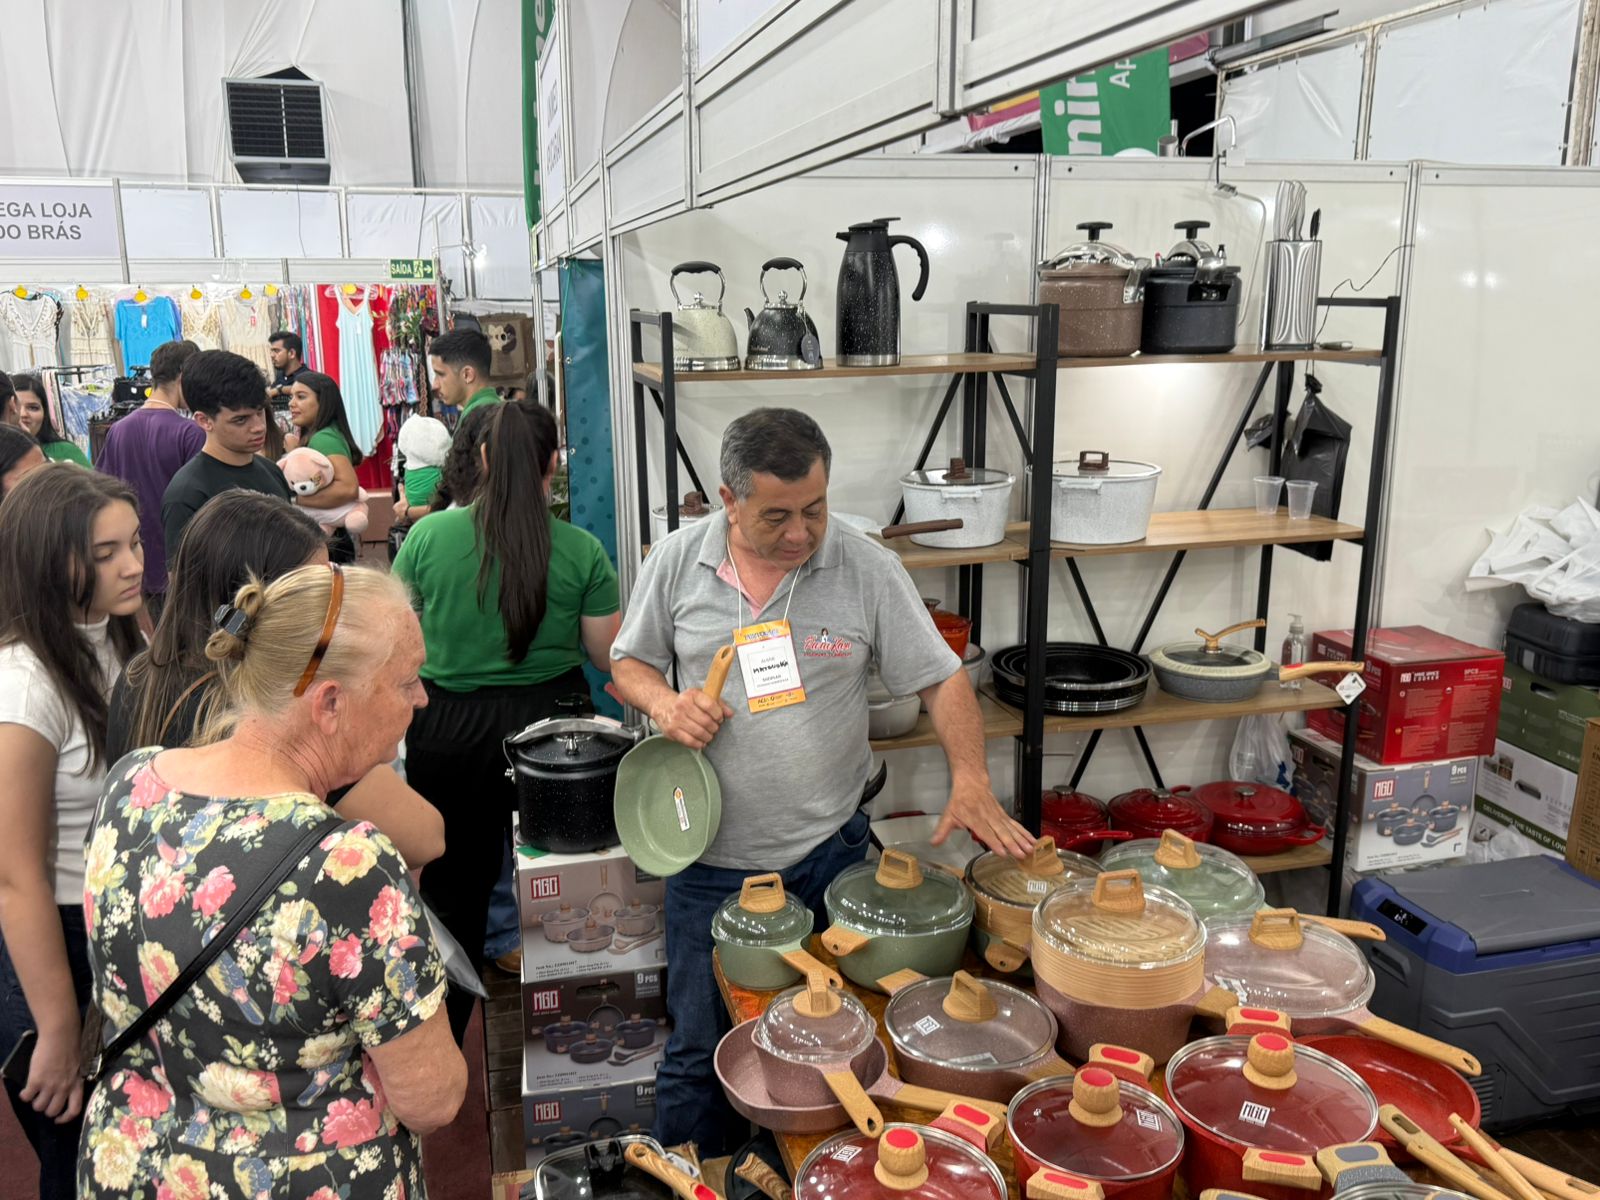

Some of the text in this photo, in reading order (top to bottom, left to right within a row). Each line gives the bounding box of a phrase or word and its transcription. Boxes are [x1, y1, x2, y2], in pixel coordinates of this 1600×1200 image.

[41, 202, 92, 218] LOJA
[28, 220, 82, 240] BRÁS
[391, 260, 412, 275] SAÍDA
[1525, 826, 1542, 840] TASTE
[645, 975, 658, 983] PCS
